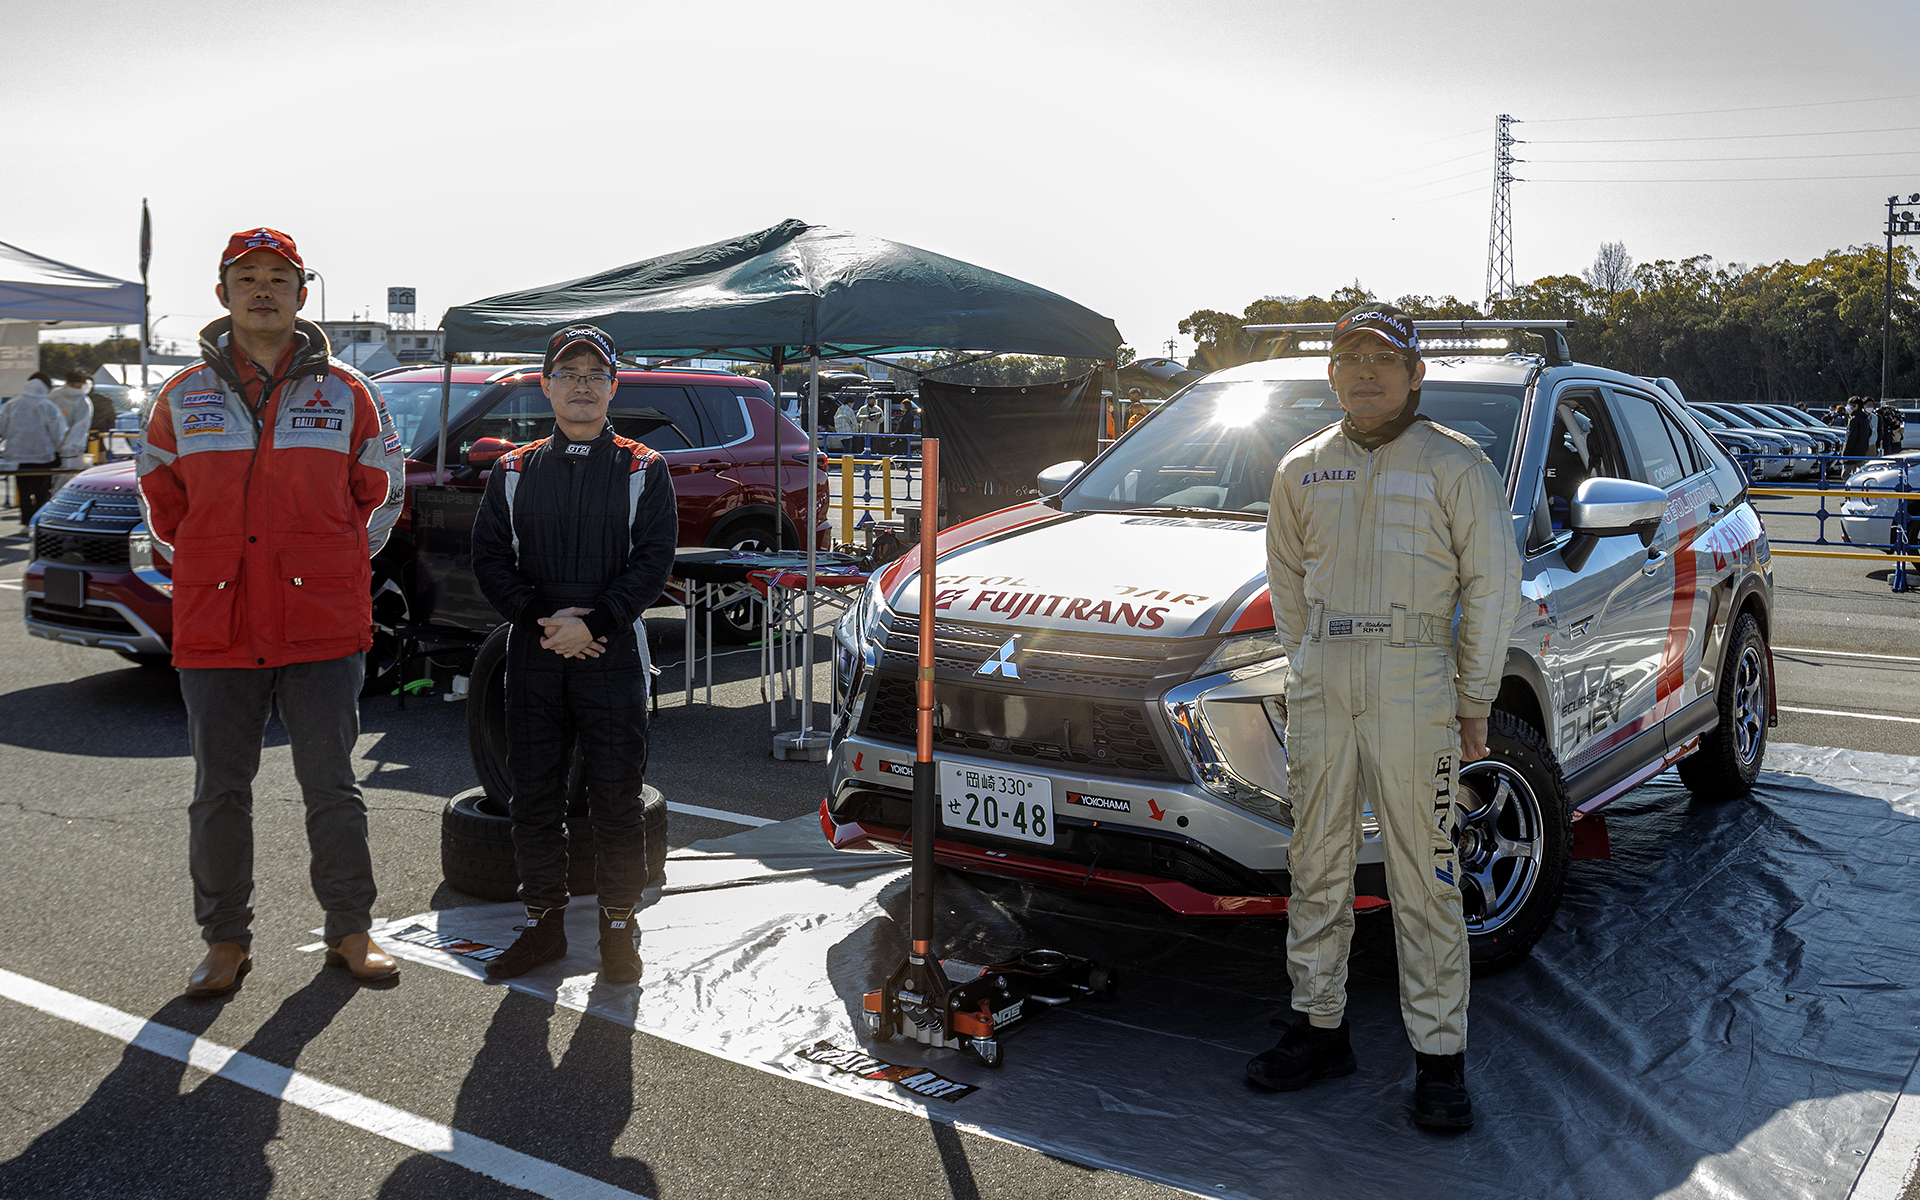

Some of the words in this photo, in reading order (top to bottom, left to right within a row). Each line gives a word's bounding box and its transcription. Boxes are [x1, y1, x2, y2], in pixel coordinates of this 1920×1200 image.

[1351, 311, 1407, 336] YOKOHAMA
[565, 329, 611, 352] YOKOHAMA
[185, 394, 223, 402] REPSOL
[183, 413, 224, 424] ATS
[1312, 469, 1357, 483] LAILE
[417, 493, 474, 505] ECLIPSE
[968, 590, 1170, 630] FUJITRANS
[1562, 689, 1598, 719] ECLIPSE
[1599, 677, 1625, 698] CROSS
[1560, 692, 1624, 754] PHEV
[890, 763, 914, 777] YOKOH
[966, 771, 996, 792] 岡崎
[998, 776, 1026, 796] 330
[947, 797, 962, 815] せ
[964, 792, 1047, 838] 20-48
[1080, 795, 1130, 812] YOKOHAMA
[992, 999, 1024, 1026] NOS
[899, 1072, 969, 1099] ART
